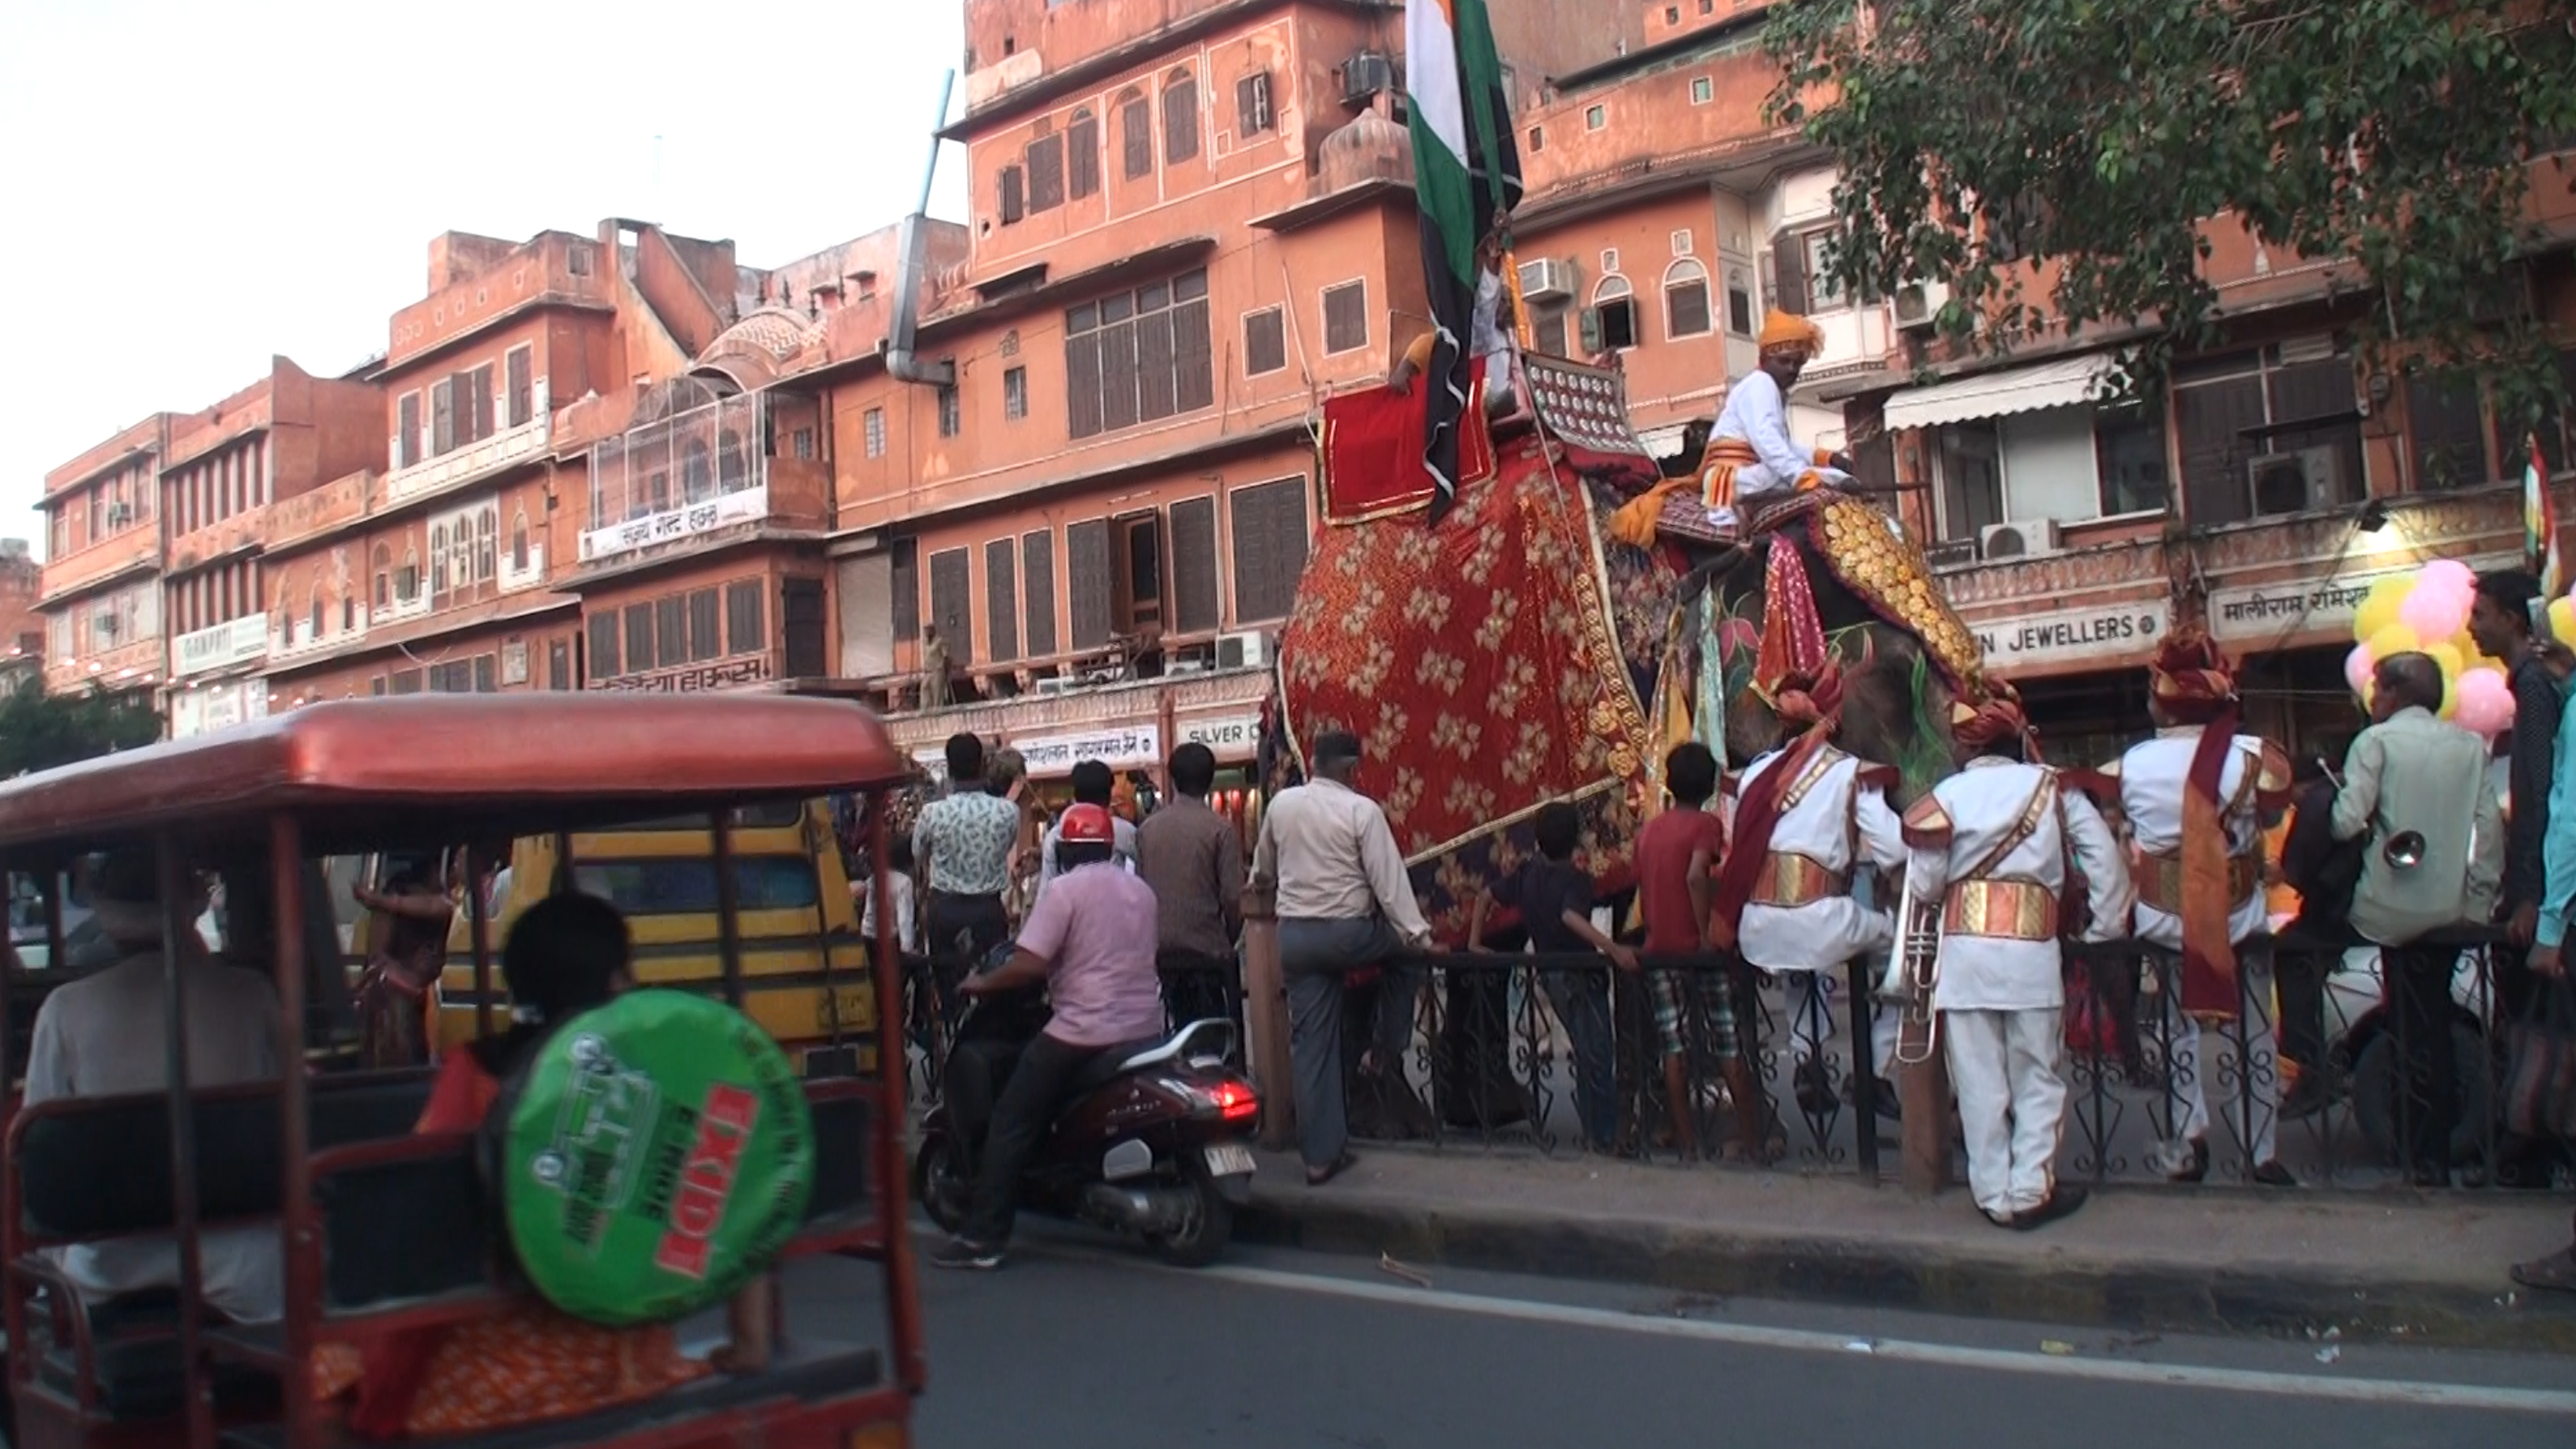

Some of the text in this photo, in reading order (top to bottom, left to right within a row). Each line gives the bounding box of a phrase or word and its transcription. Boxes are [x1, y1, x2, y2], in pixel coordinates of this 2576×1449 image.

[2223, 592, 2305, 622] मालीराम
[2009, 616, 2134, 652] JEWELLERS
[1189, 725, 1243, 744] SILVER
[654, 1081, 761, 1281] EXIDE
